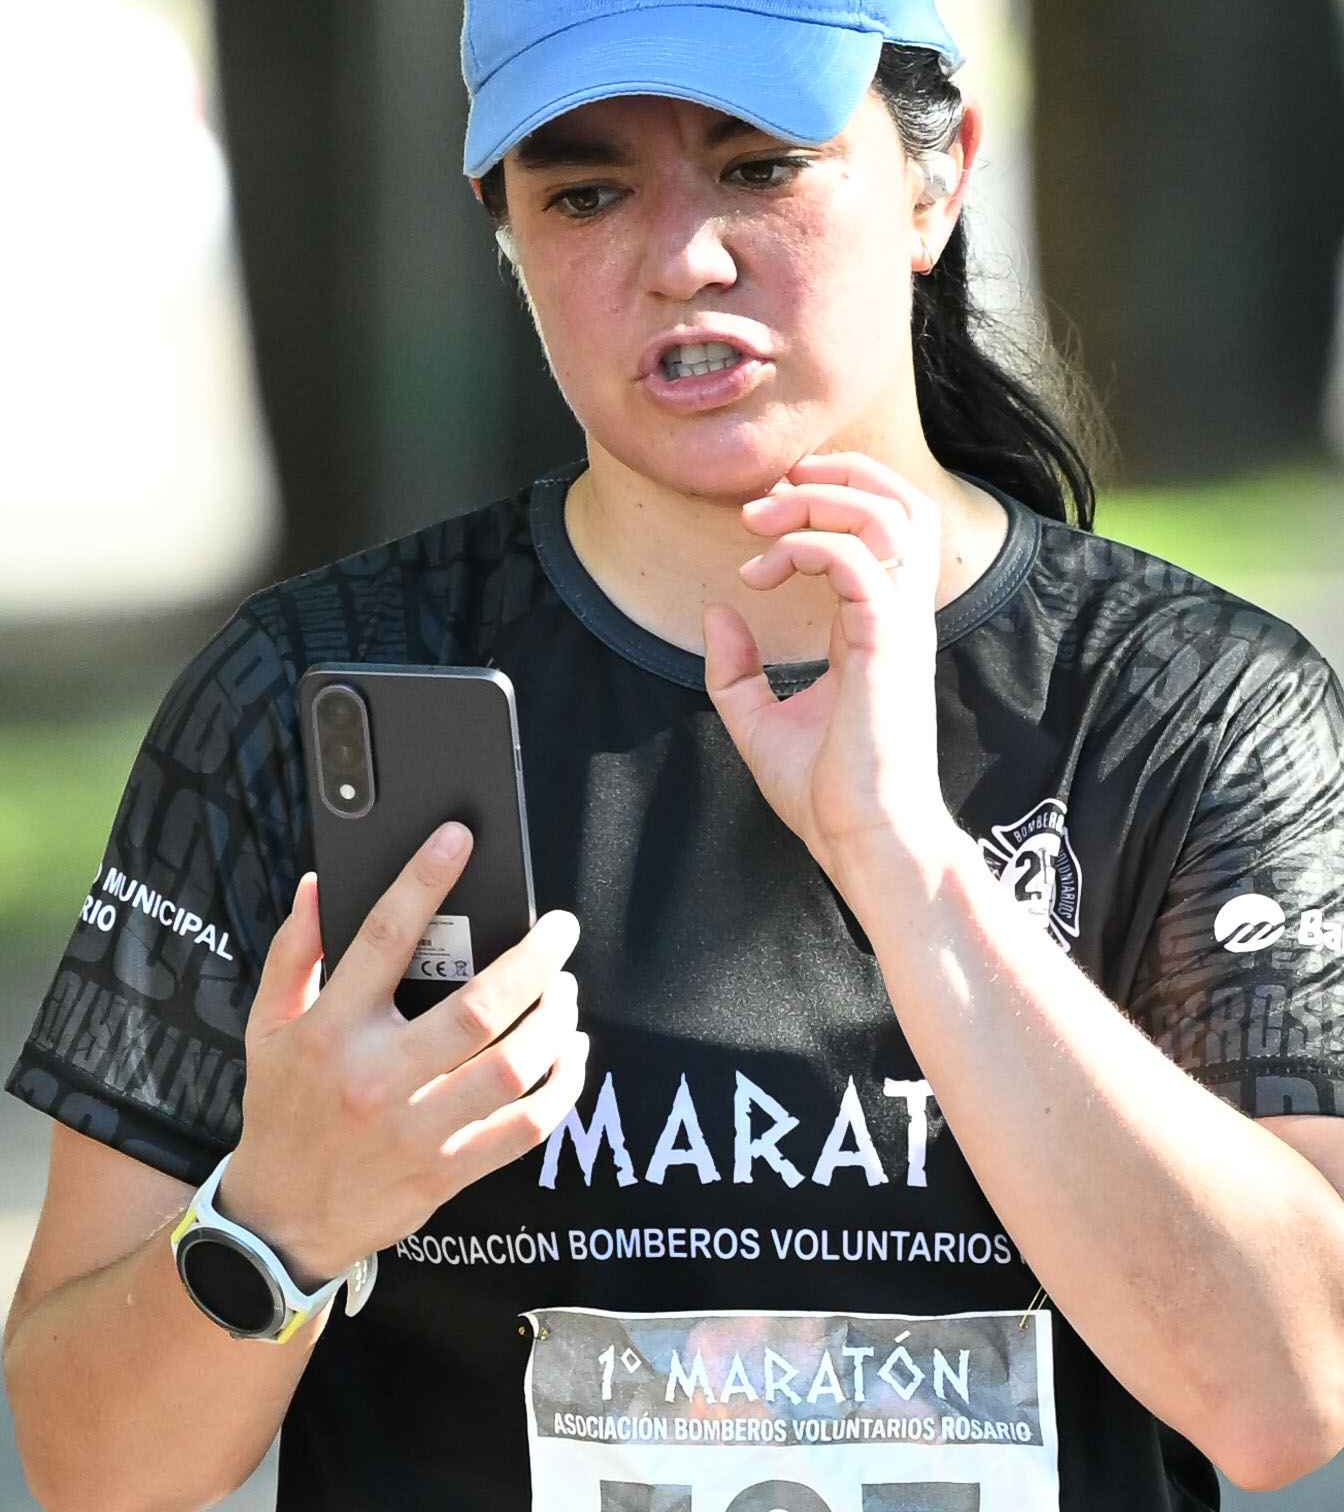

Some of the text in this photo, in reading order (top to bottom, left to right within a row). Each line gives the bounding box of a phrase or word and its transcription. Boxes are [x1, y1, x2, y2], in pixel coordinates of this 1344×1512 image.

[102, 867, 234, 961] MUNICIPAL
[537, 1069, 935, 1190] MARAT
[395, 1225, 1012, 1265] ASOCIACIÓN BOMBEROS VOLUNTARIOS
[664, 1329, 973, 1406] MARATÓN
[553, 1411, 1033, 1443] ASOCIACIÓN BOMBEROS VOLUNTARIOS ROSARIO
